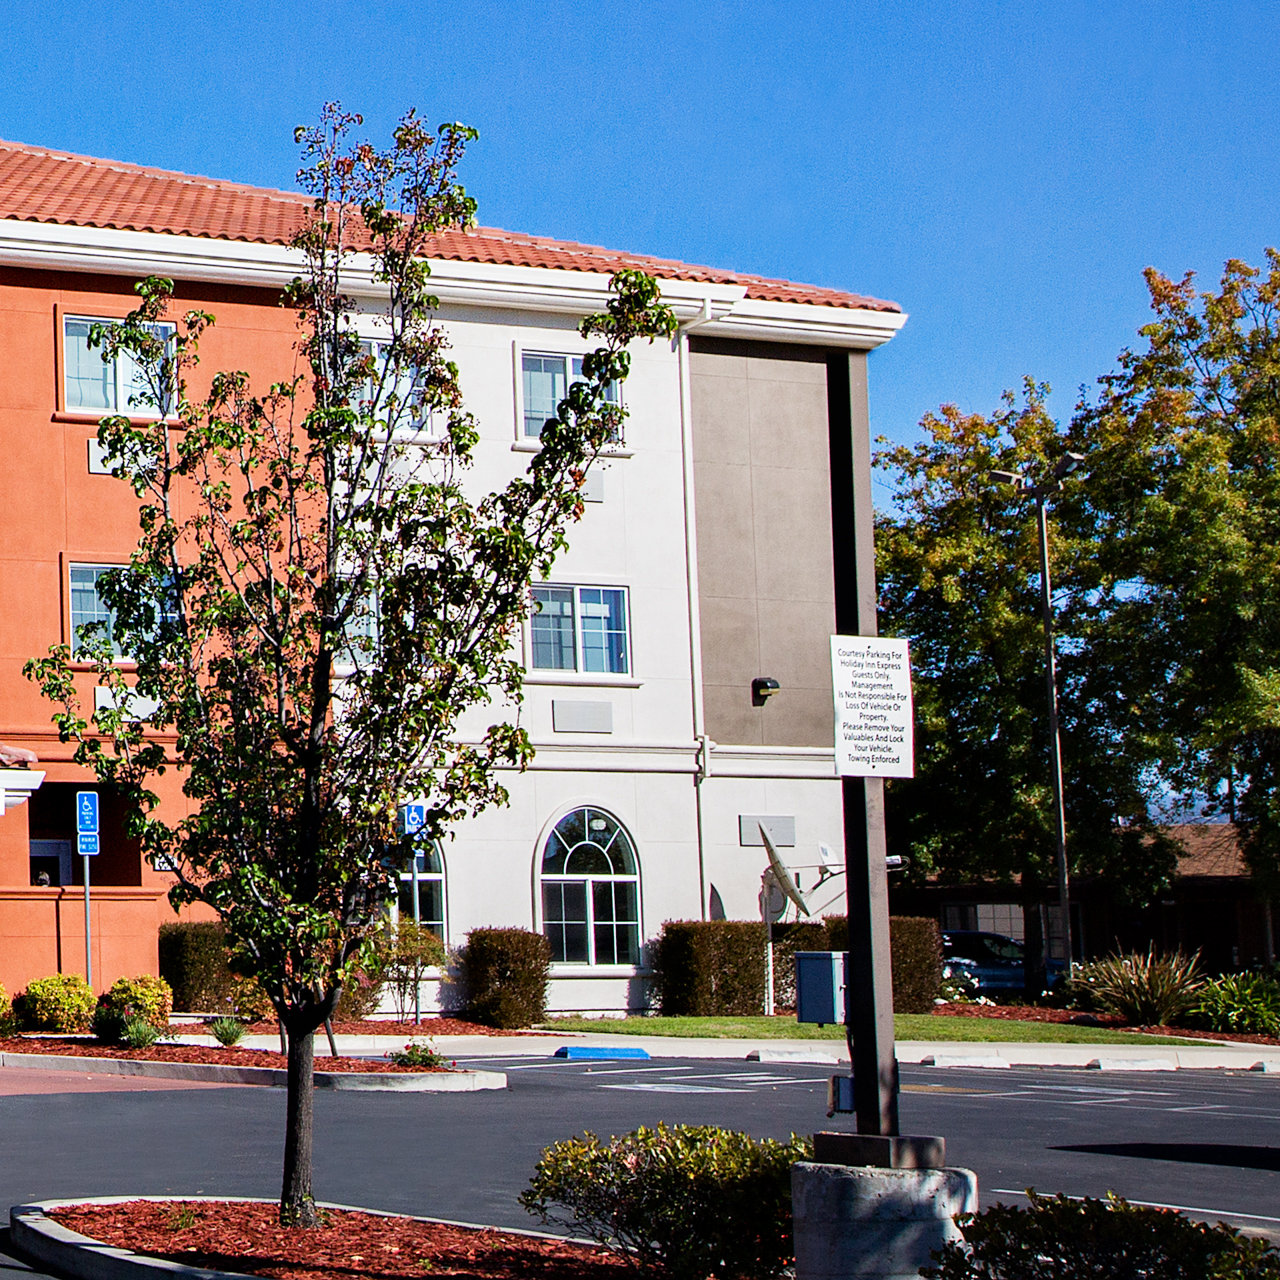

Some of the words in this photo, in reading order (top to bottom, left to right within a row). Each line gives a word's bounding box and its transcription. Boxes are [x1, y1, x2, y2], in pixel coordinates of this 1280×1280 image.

[838, 648, 865, 659] Courtesy
[866, 650, 890, 661] Parking
[892, 651, 902, 659] For
[840, 660, 864, 669] Holiday
[877, 661, 901, 670] Express
[852, 670, 873, 678] Guests
[851, 681, 893, 691] Management
[845, 691, 856, 699] Not
[858, 691, 896, 700] Responsible
[897, 693, 907, 701] For
[846, 701, 859, 709] Loss
[861, 702, 868, 710] Of
[870, 702, 892, 711] Vehicle
[893, 703, 901, 711] Or
[843, 722, 863, 730] Please
[864, 723, 889, 732] Remove
[890, 724, 905, 732] Your
[844, 733, 874, 742] Valuables
[875, 734, 888, 742] And
[854, 744, 868, 752] Your
[848, 753, 870, 764] Towing
[872, 755, 900, 764] Enforced
